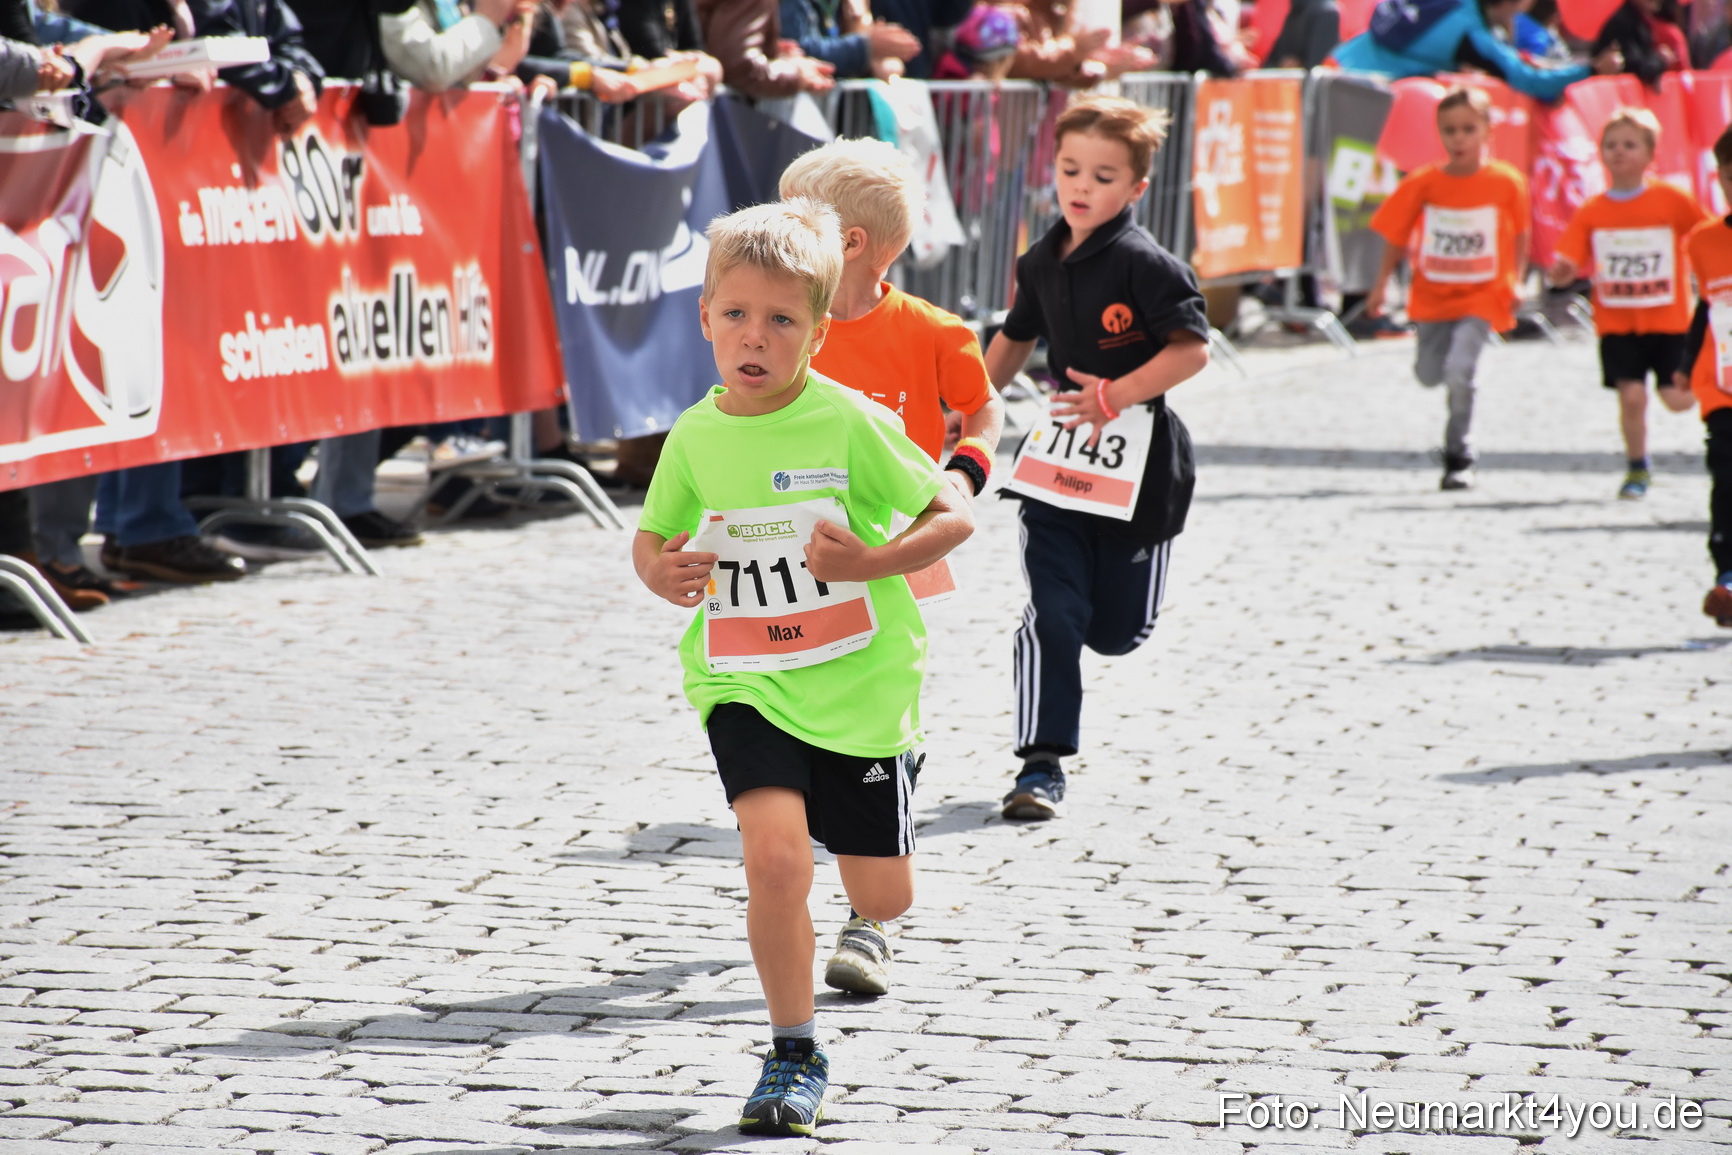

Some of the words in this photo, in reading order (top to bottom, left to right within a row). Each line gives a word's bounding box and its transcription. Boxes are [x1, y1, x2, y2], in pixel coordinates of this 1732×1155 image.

[1433, 230, 1485, 256] 7209
[1606, 252, 1662, 277] 7257
[1047, 420, 1127, 469] 7143
[1053, 472, 1093, 494] Philipp
[740, 520, 796, 537] BOCK
[709, 602, 721, 611] B2
[767, 624, 805, 642] Max
[863, 774, 890, 783] adidas
